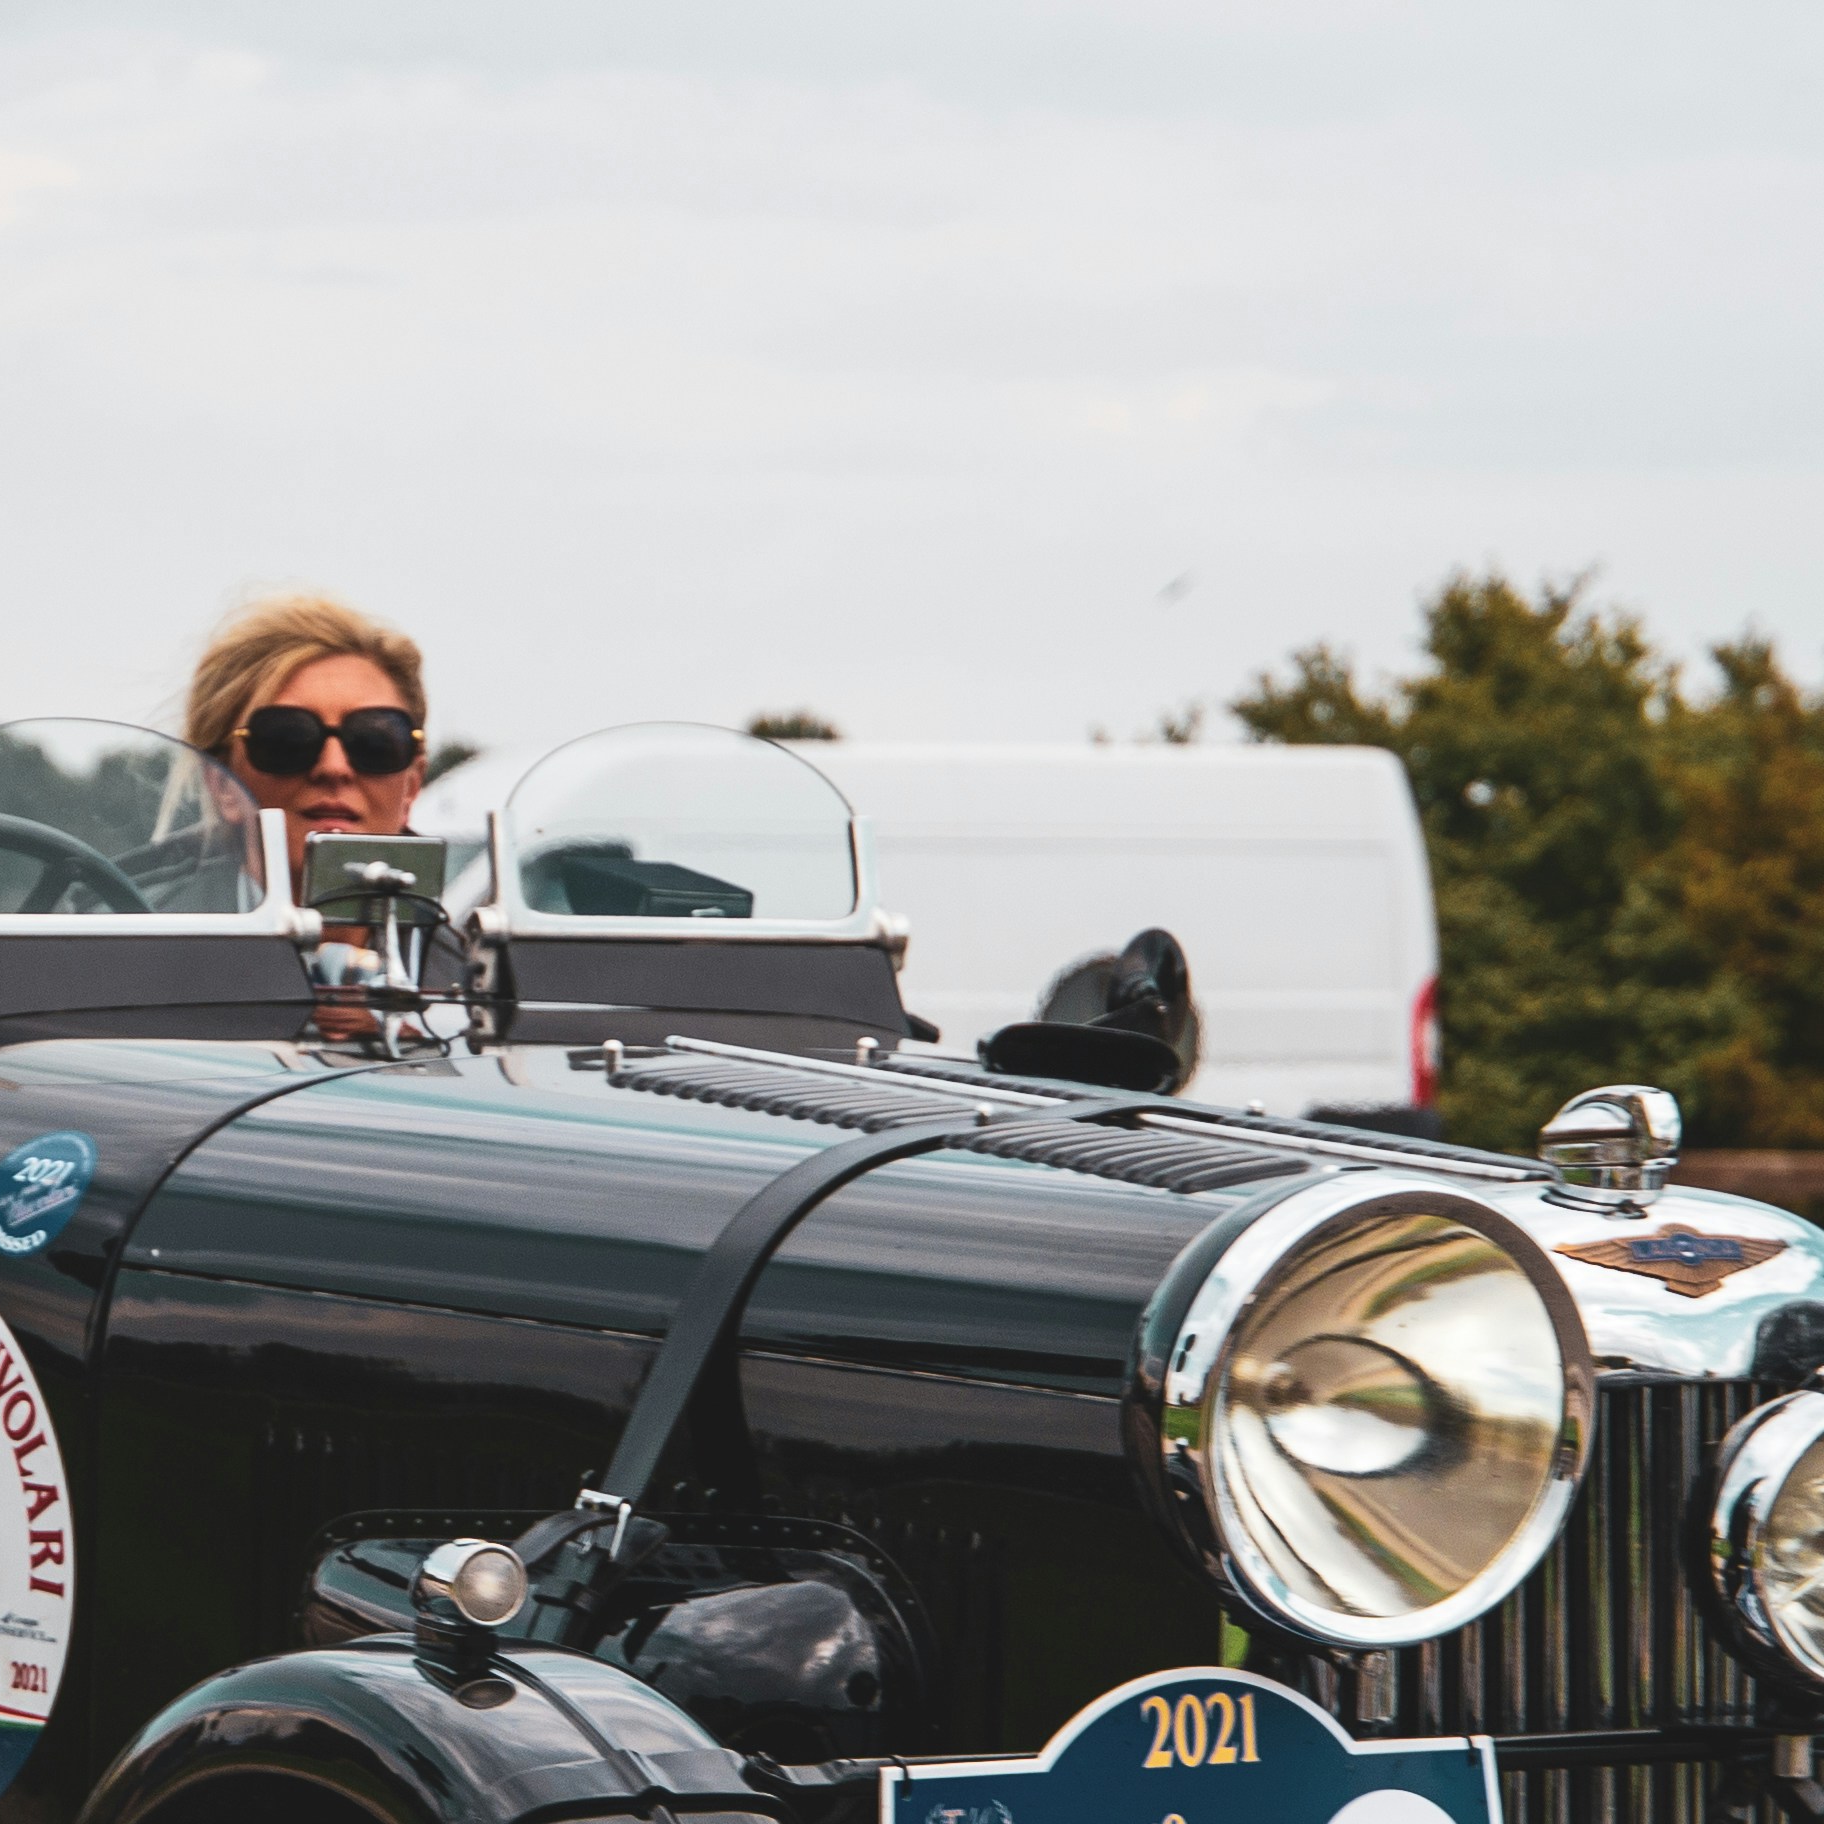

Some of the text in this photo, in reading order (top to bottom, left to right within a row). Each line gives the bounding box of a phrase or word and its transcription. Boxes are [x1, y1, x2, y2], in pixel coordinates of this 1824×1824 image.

[13, 1157, 75, 1187] 2021
[11, 1661, 48, 1693] 2021
[1141, 1692, 1261, 1769] 2021
